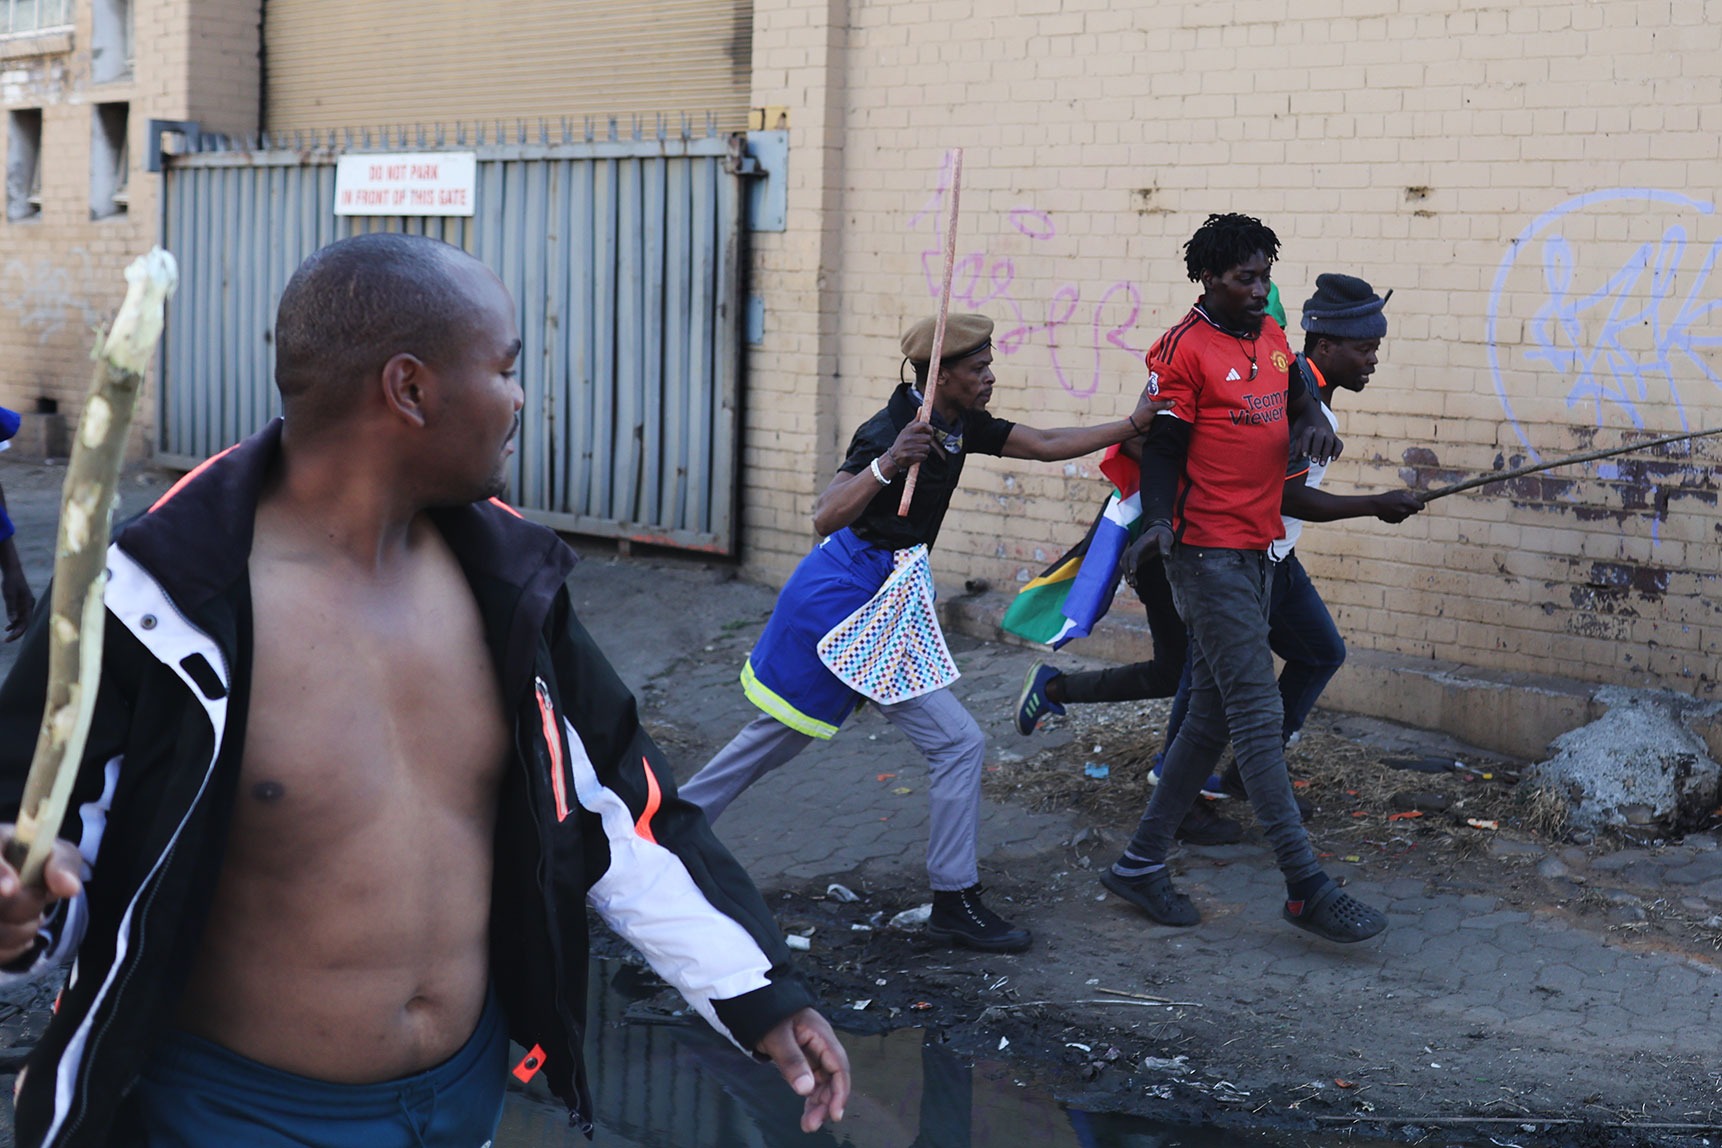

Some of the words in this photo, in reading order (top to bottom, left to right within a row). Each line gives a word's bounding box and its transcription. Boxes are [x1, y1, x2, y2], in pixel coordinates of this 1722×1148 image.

[368, 164, 382, 181] DO
[387, 164, 407, 181] NOT
[410, 164, 439, 181] PARK
[341, 189, 352, 205] IN
[355, 188, 389, 205] FRONT
[392, 188, 406, 205] OF
[410, 188, 434, 205] THIS
[438, 188, 466, 205] GATE
[1243, 391, 1283, 411] Team
[1229, 406, 1284, 426] Viewer
